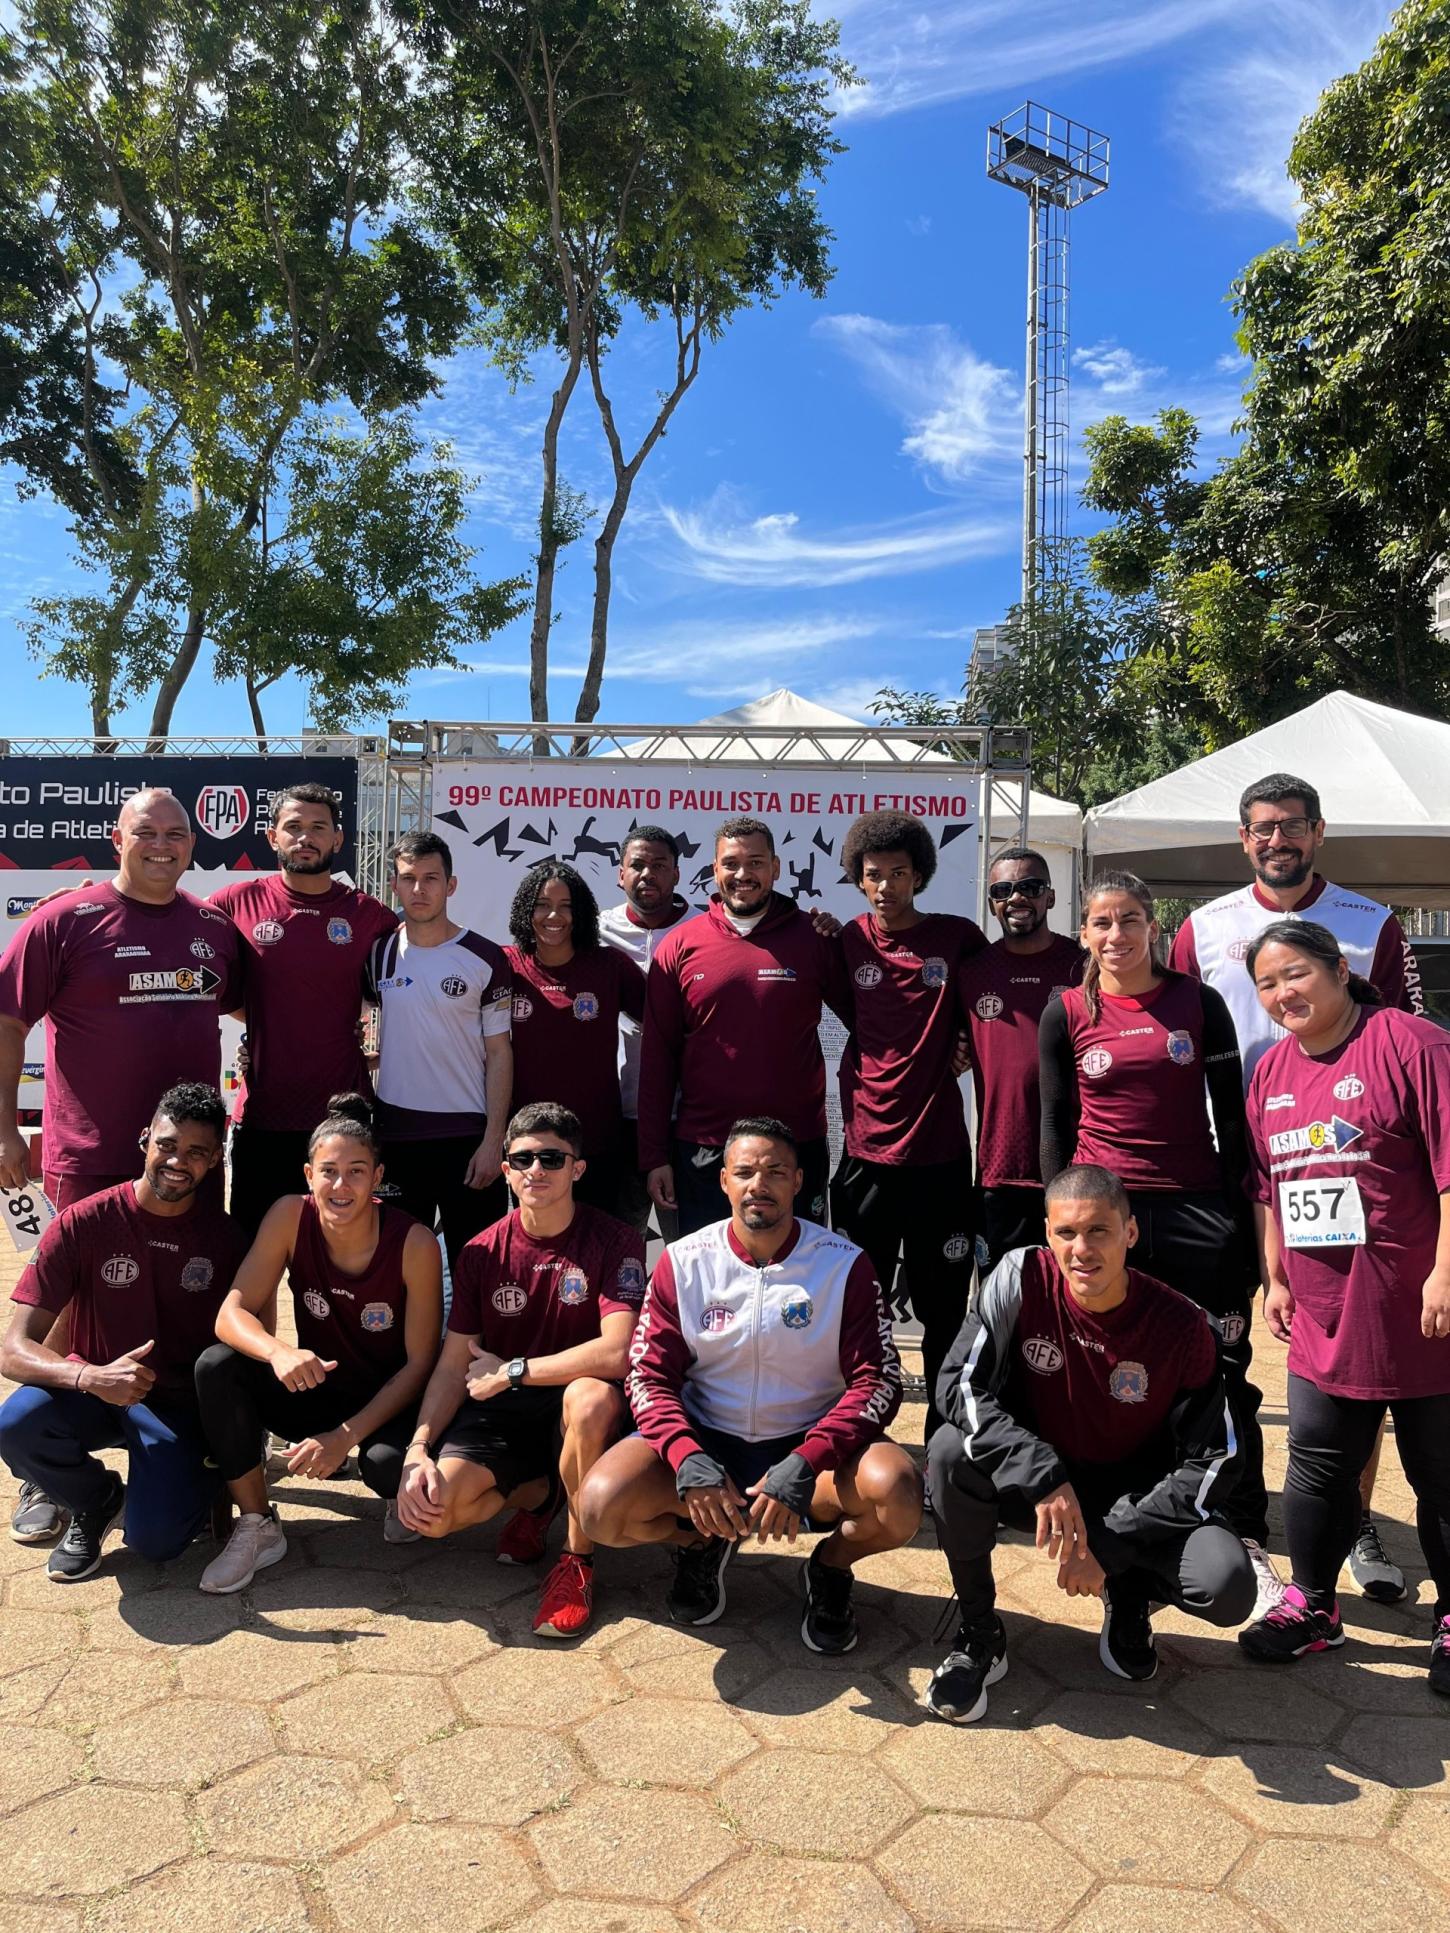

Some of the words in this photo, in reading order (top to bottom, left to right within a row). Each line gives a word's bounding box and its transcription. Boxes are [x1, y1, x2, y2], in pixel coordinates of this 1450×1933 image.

[205, 791, 239, 830] FPA
[449, 785, 491, 806] 99º
[499, 786, 661, 810] CAMPEONATO
[669, 789, 782, 813] PAULISTA
[790, 793, 821, 814] DE
[828, 794, 967, 817] ATLETISMO
[13, 820, 44, 839] de
[1340, 902, 1376, 913] CASTER
[255, 923, 282, 941] AFE
[191, 941, 214, 958] AFE
[1228, 941, 1251, 961] AF
[857, 966, 881, 985] AFE
[442, 978, 467, 996] AFE
[978, 997, 1001, 1017] AFE
[1124, 1027, 1154, 1036] CASTER
[1083, 1052, 1110, 1074] AFE
[1335, 1079, 1362, 1099] AFE
[1289, 1187, 1345, 1222] 557
[1325, 1232, 1357, 1241] CAIXA
[945, 1239, 968, 1257] AFE
[103, 1259, 137, 1284] AFE
[305, 1294, 328, 1315] AFE
[494, 1288, 525, 1311] AFE
[702, 1308, 736, 1331] AFE
[1025, 1341, 1061, 1369] AFE
